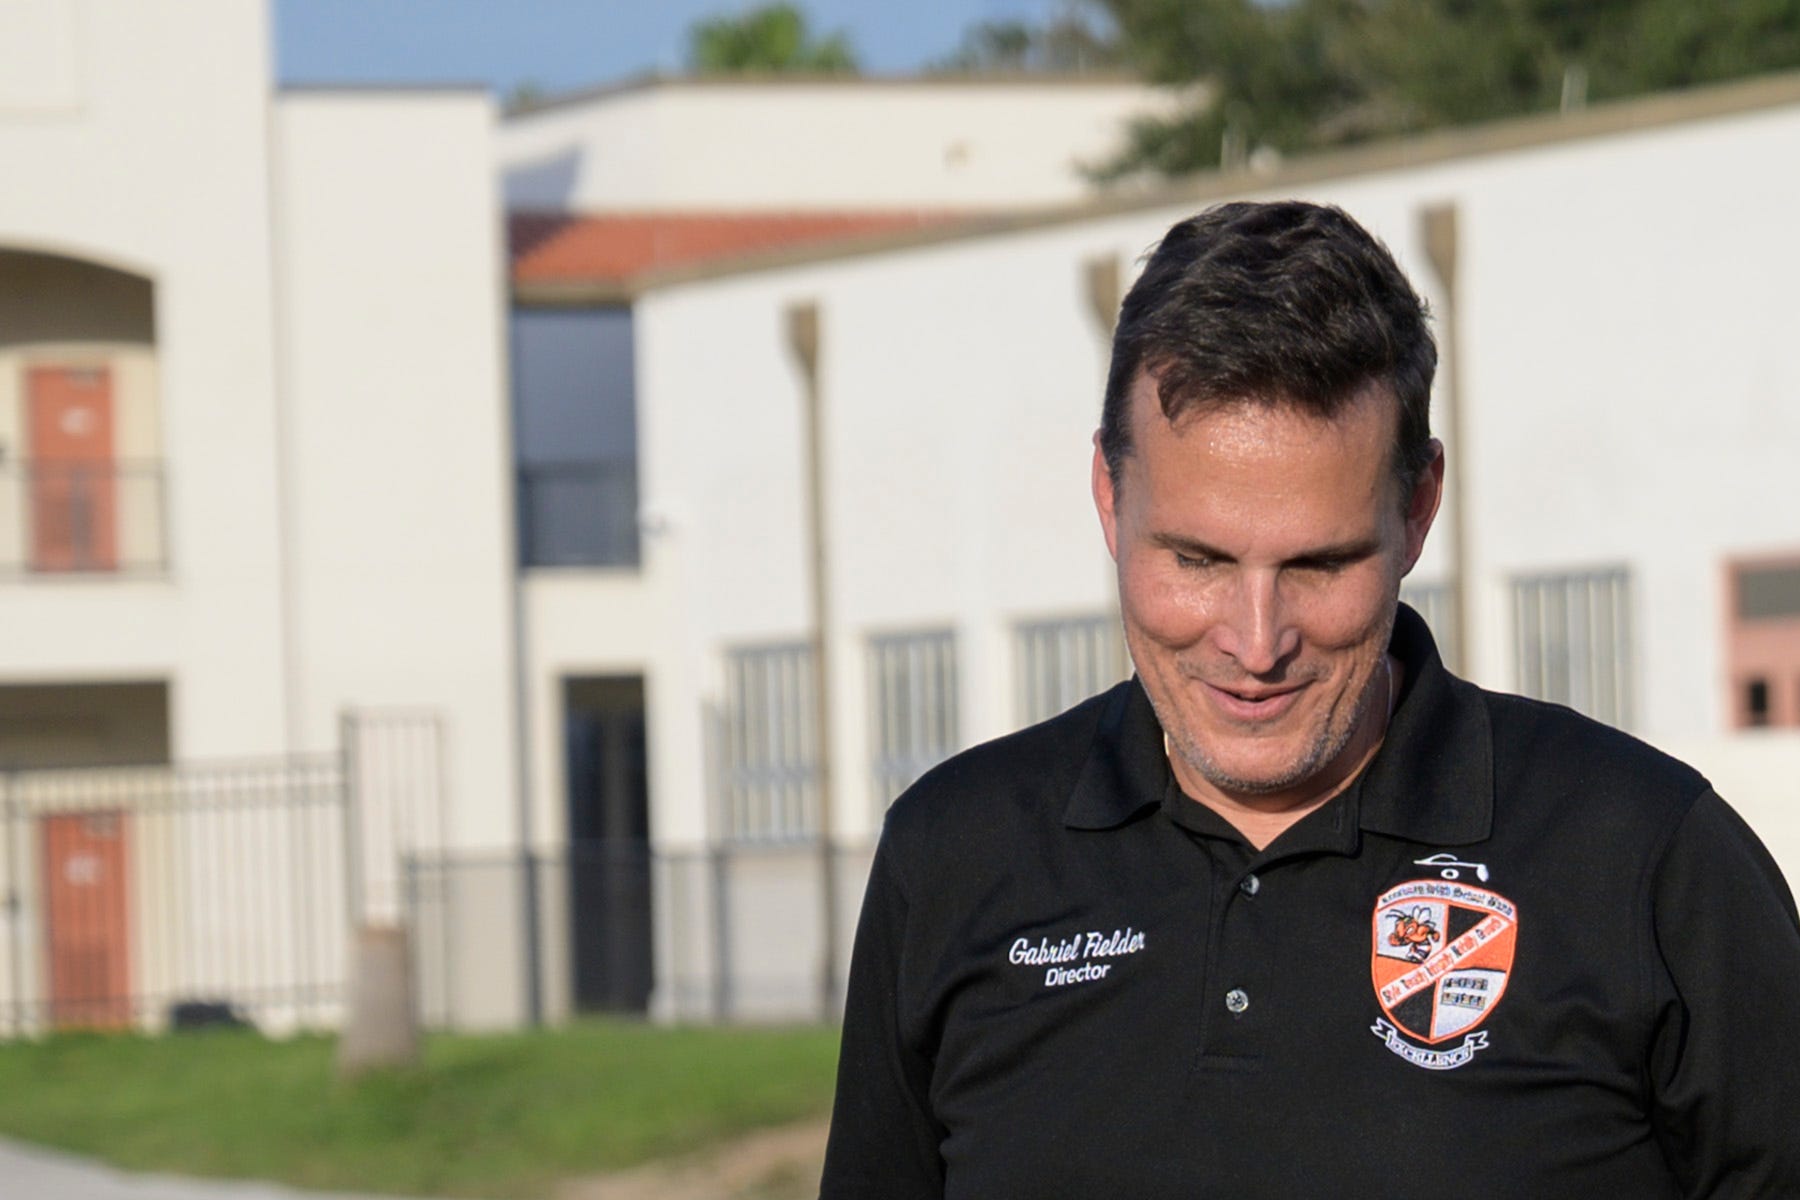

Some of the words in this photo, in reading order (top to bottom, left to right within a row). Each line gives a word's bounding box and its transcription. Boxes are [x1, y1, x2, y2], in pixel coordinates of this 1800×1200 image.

[1008, 932, 1082, 966] Gabriel
[1083, 927, 1146, 959] Fielder
[1044, 962, 1112, 987] Director
